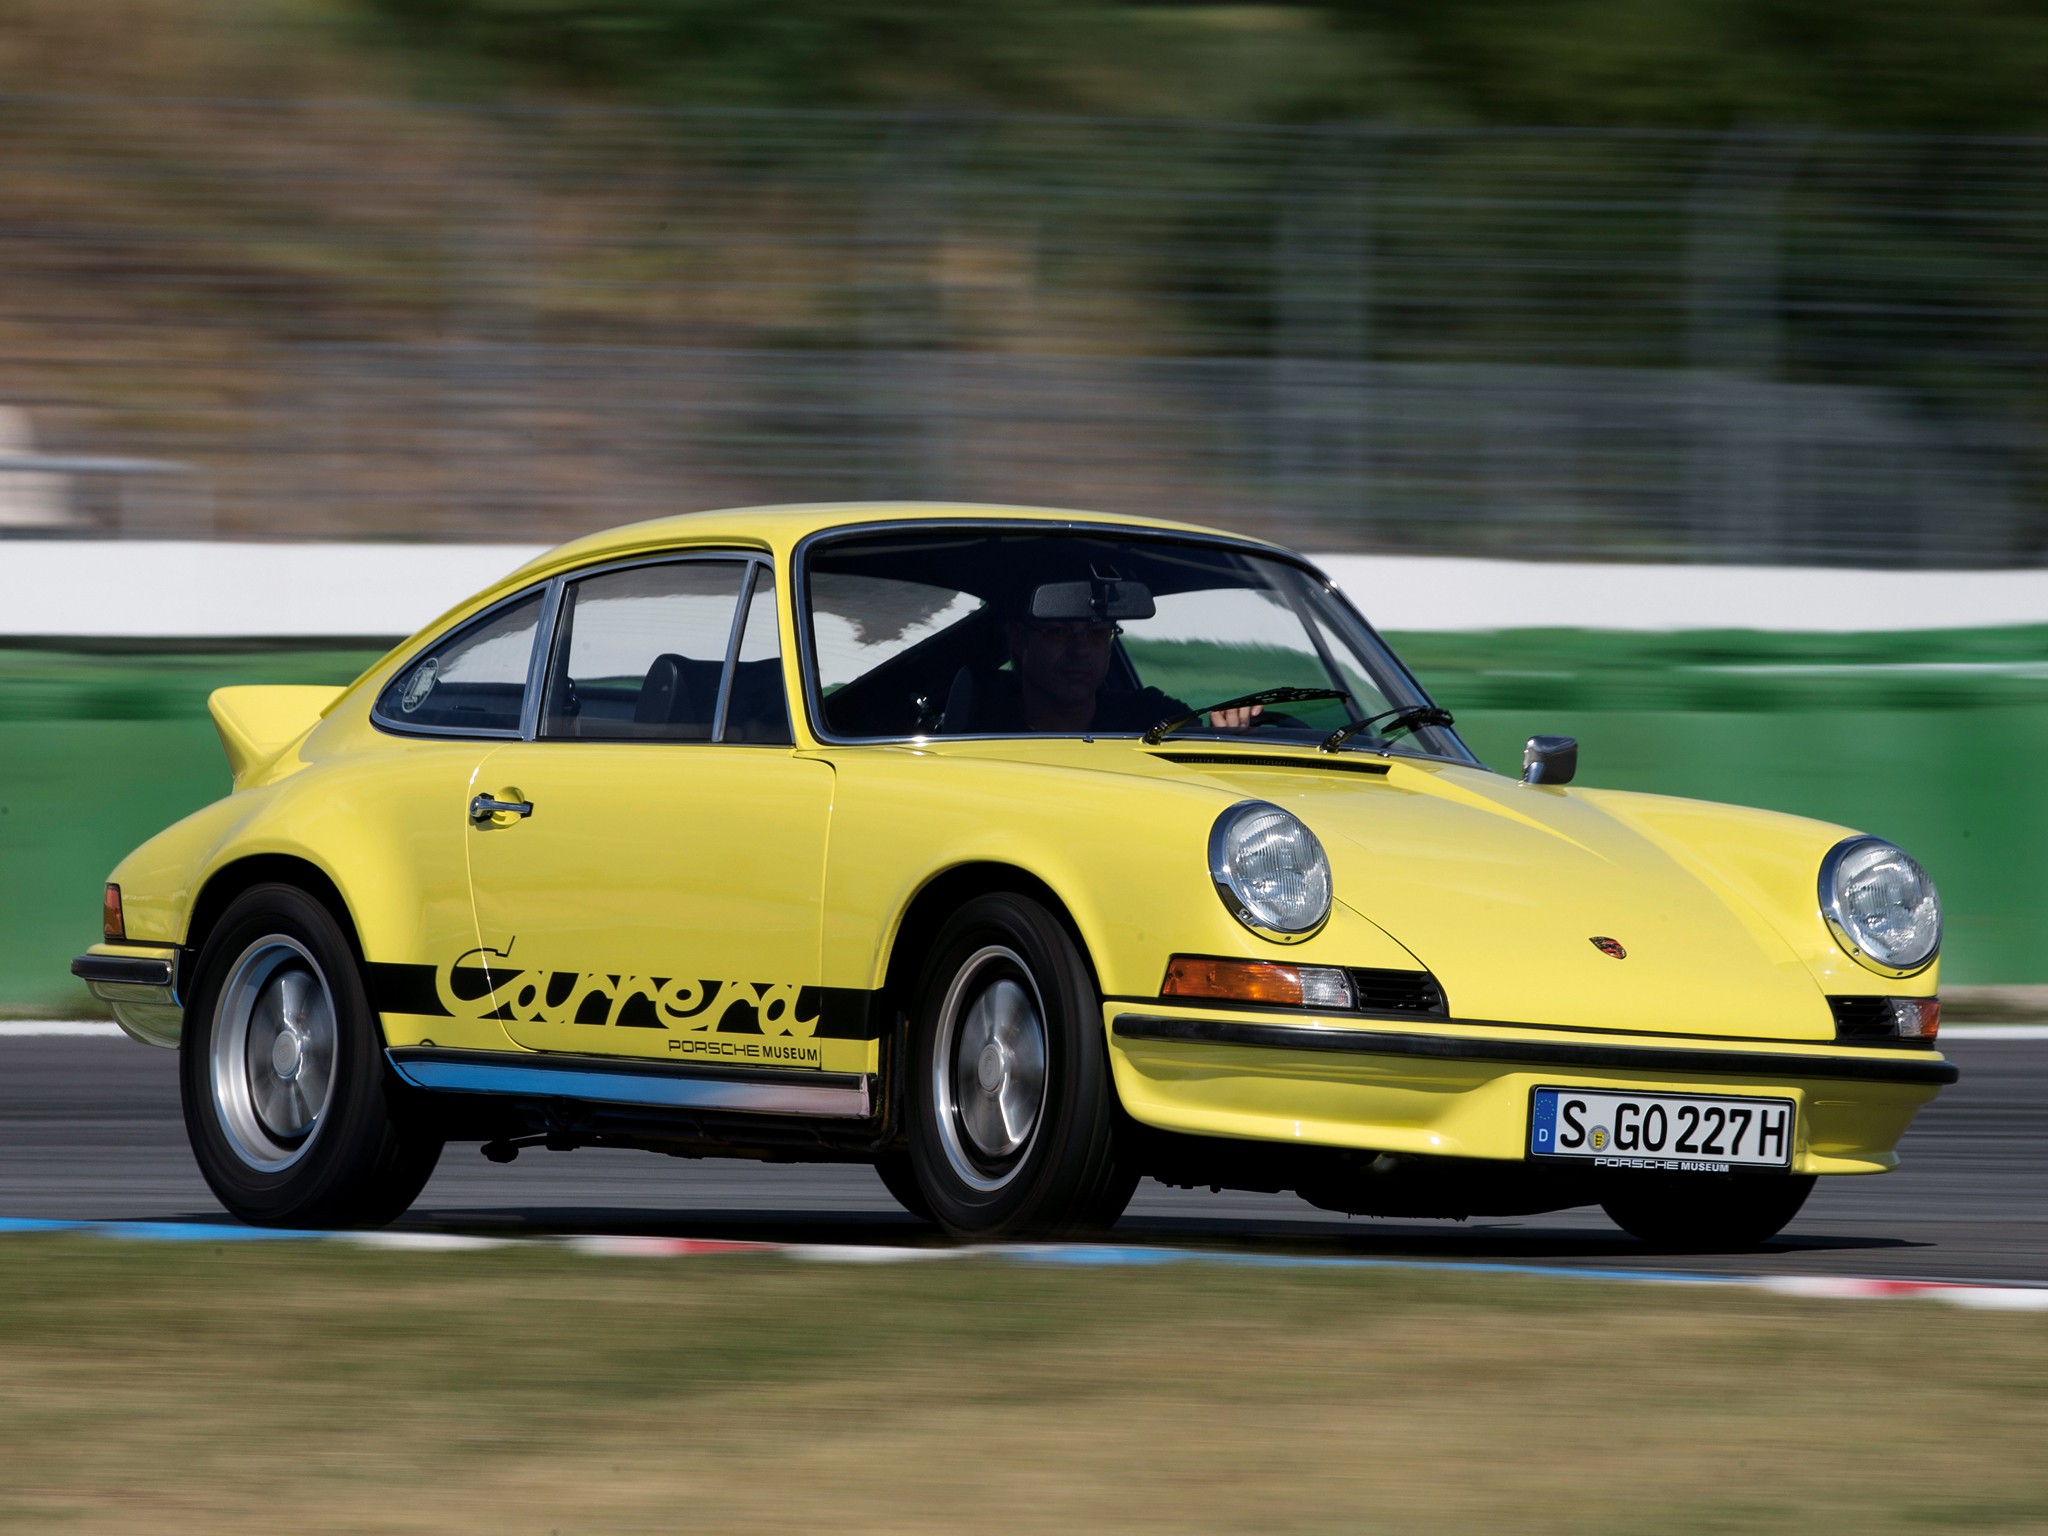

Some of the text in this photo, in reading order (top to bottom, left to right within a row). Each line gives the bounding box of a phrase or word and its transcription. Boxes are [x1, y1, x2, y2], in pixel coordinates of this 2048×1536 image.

[434, 936, 821, 1038] Carrera
[669, 1039, 818, 1061] PORSCHE MUSEUM
[1560, 1100, 1587, 1149] S
[1538, 1129, 1550, 1143] D
[1594, 1158, 1730, 1173] PORSCHE MUSEUM
